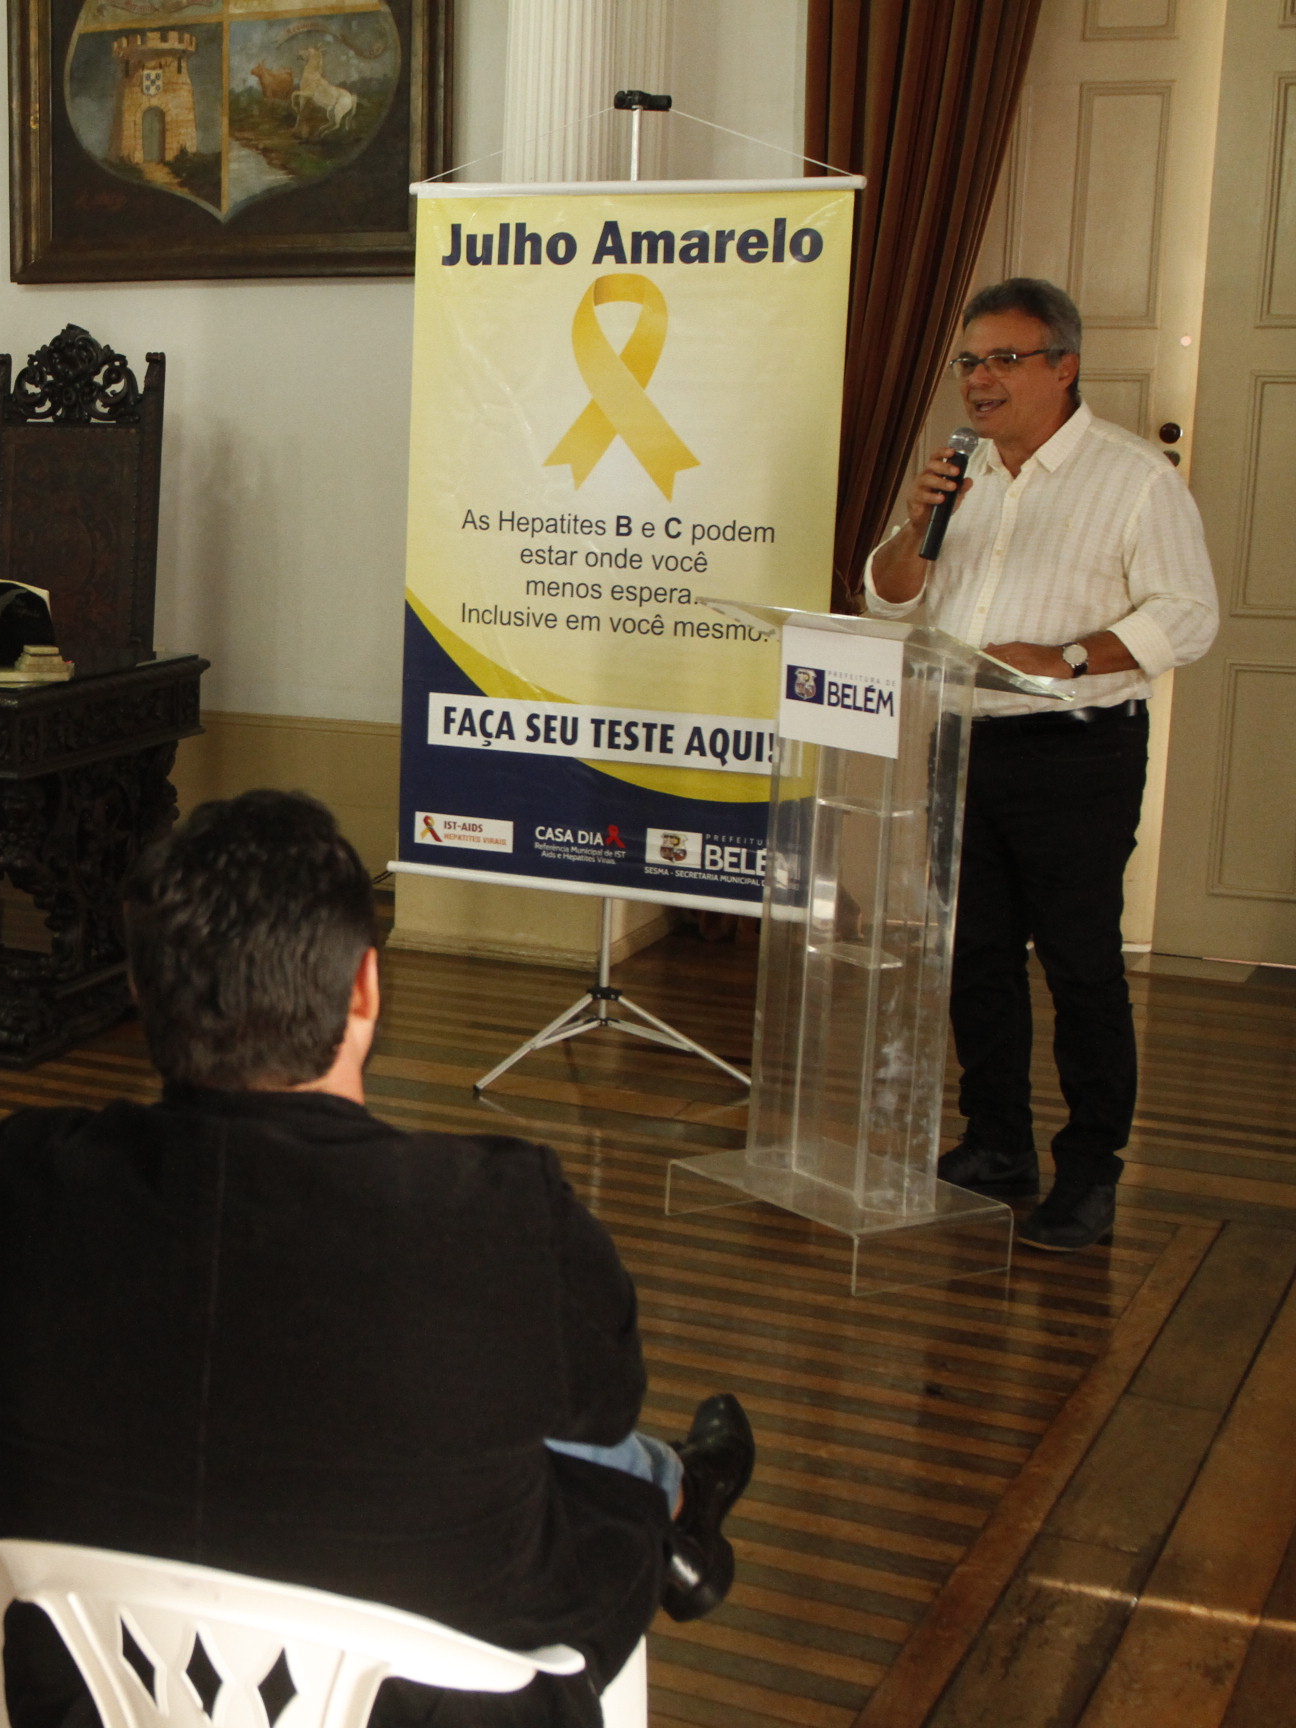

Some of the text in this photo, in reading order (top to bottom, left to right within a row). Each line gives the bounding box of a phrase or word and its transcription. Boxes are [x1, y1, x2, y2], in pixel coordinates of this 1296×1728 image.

[441, 217, 824, 267] Julho Amarelo
[461, 508, 776, 546] As Hepatites B e C podem
[520, 544, 709, 573] estar onde você
[525, 579, 699, 608] menos espera.
[461, 602, 558, 629] Inclusive
[565, 613, 601, 632] em
[609, 614, 665, 636] você
[827, 670, 896, 687] PREFEITURA DE
[826, 681, 895, 717] BELÉM
[443, 706, 775, 767] FAÇA SEU TESTE AQUI!
[443, 820, 484, 833] IST-AIDS
[534, 826, 604, 846] CASA DIA
[443, 833, 507, 846] HEPATITES VIRAIS
[705, 833, 766, 846] PREFEITU
[540, 850, 556, 859] Aids
[562, 853, 596, 863] Hepatites
[570, 845, 604, 857] Municipal
[604, 849, 613, 857] de
[614, 850, 626, 859] IST
[643, 866, 669, 876] SESMA
[675, 870, 719, 881] SECRETARIA
[719, 875, 761, 887] MUNICIPAL
